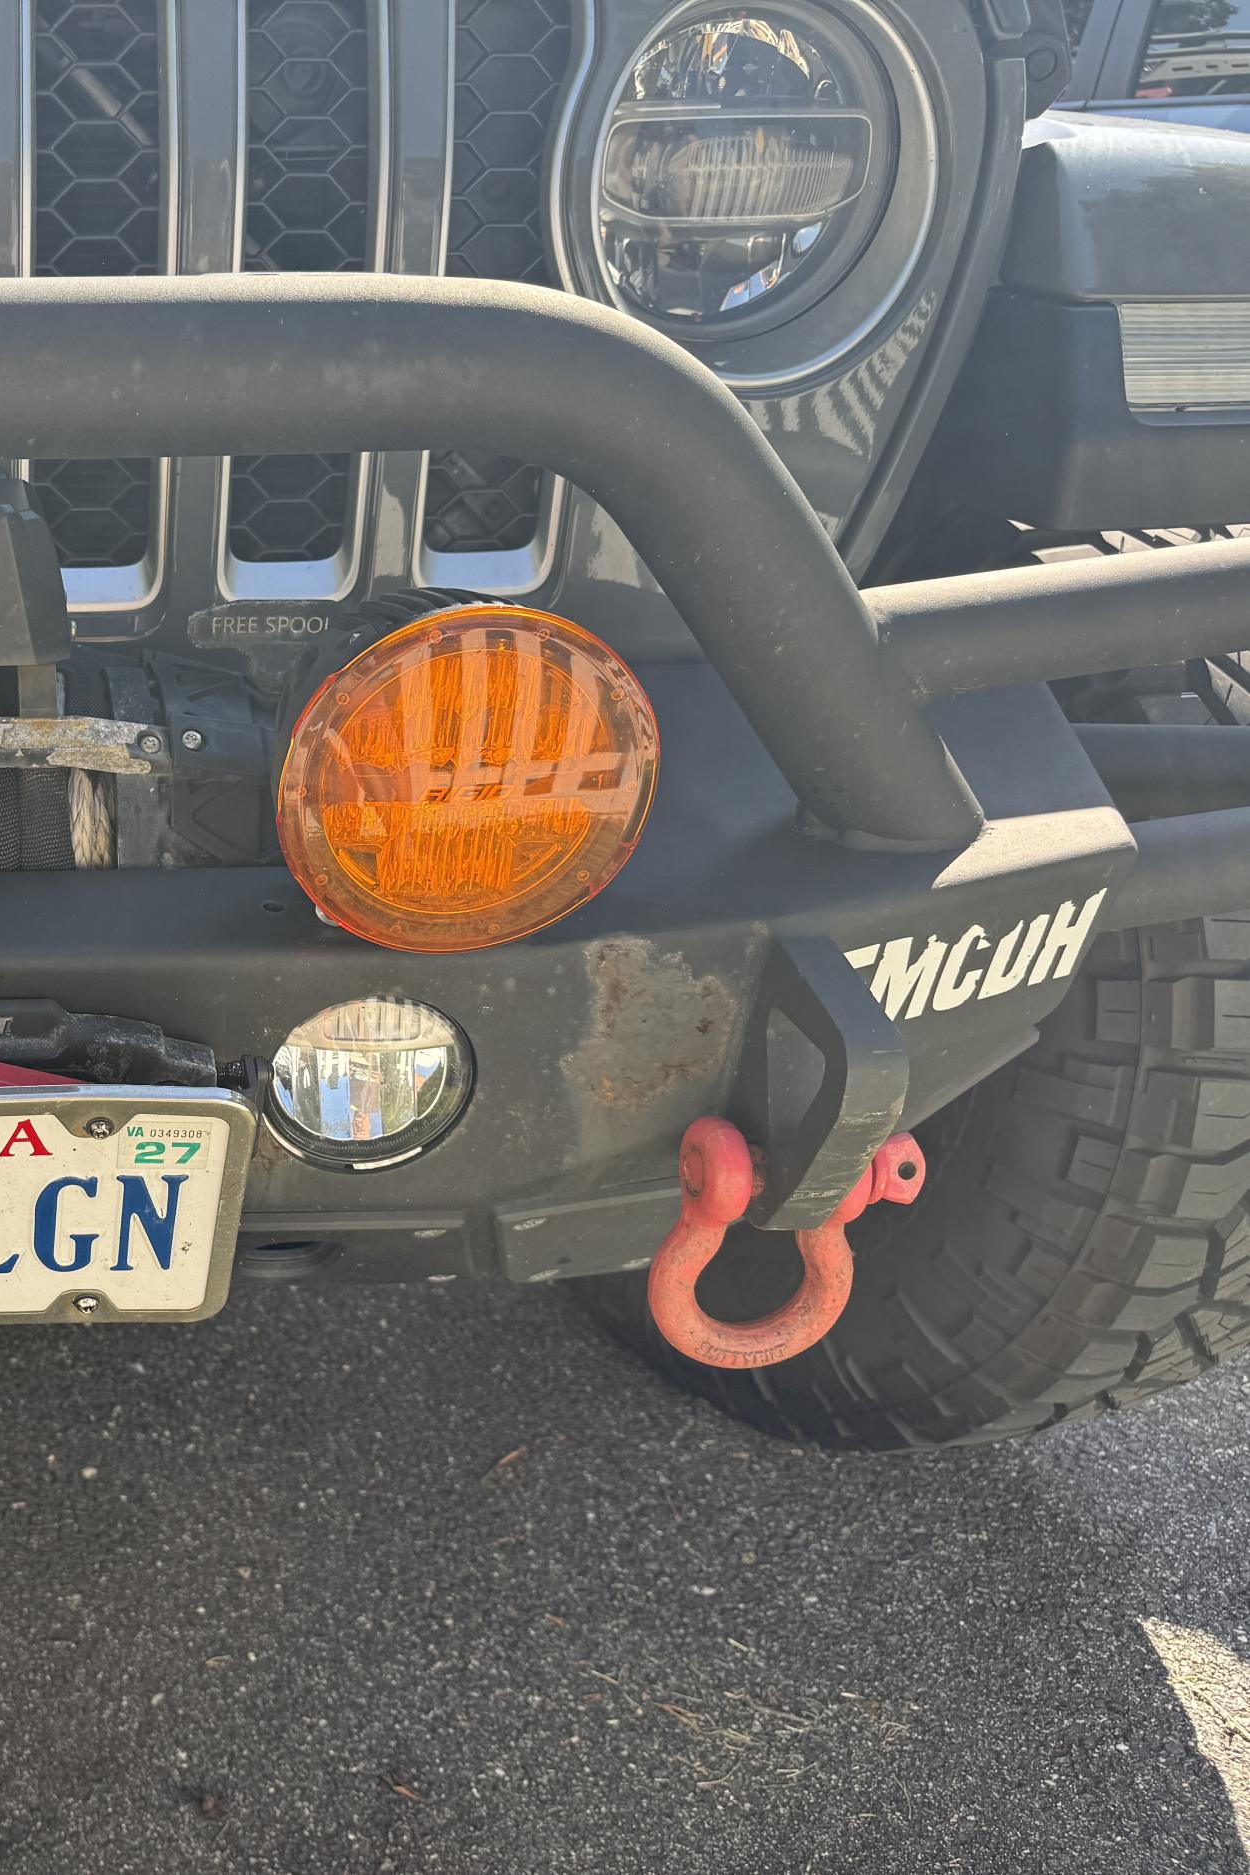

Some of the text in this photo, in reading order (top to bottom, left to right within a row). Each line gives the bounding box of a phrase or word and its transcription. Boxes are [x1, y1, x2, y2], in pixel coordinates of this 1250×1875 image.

[211, 616, 258, 634] FREE
[127, 1127, 202, 1139] VA 0349308
[134, 1141, 201, 1165] 27
